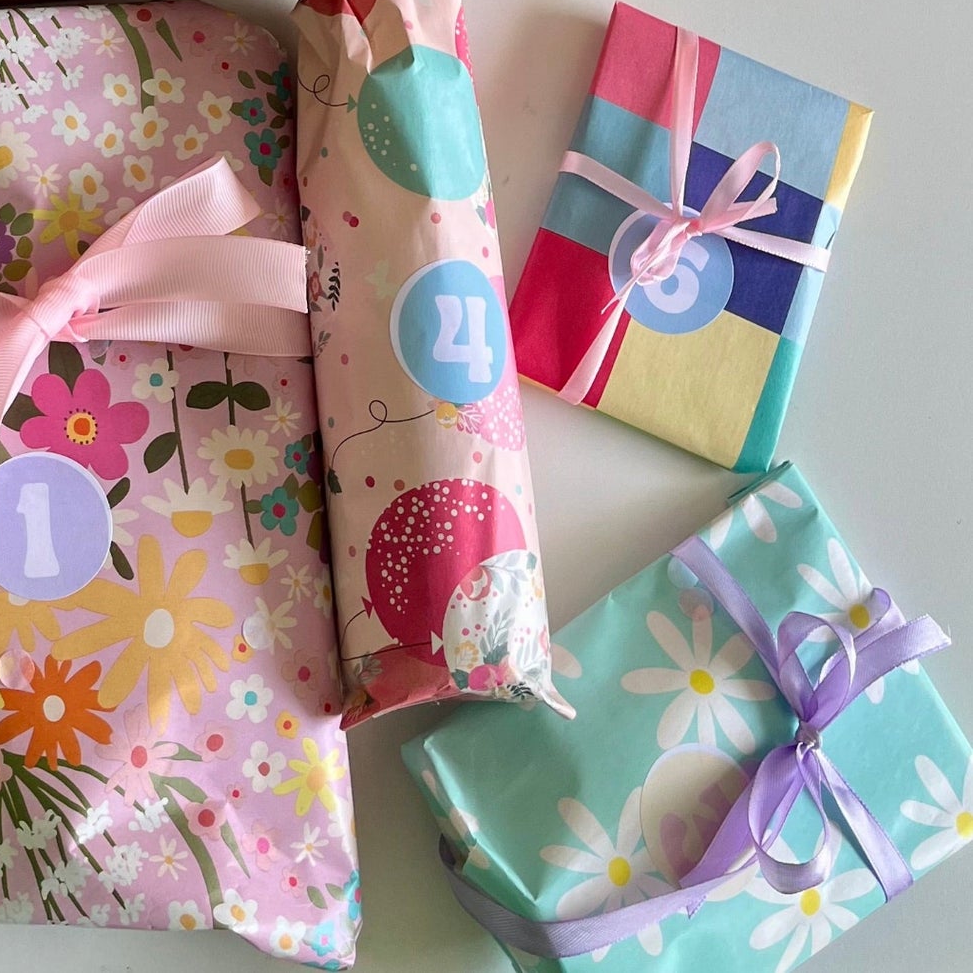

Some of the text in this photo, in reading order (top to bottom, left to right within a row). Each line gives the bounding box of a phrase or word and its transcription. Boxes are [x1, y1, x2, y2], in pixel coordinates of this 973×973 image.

[642, 239, 711, 315] 6
[433, 294, 493, 384] 4
[16, 482, 61, 579] 1
